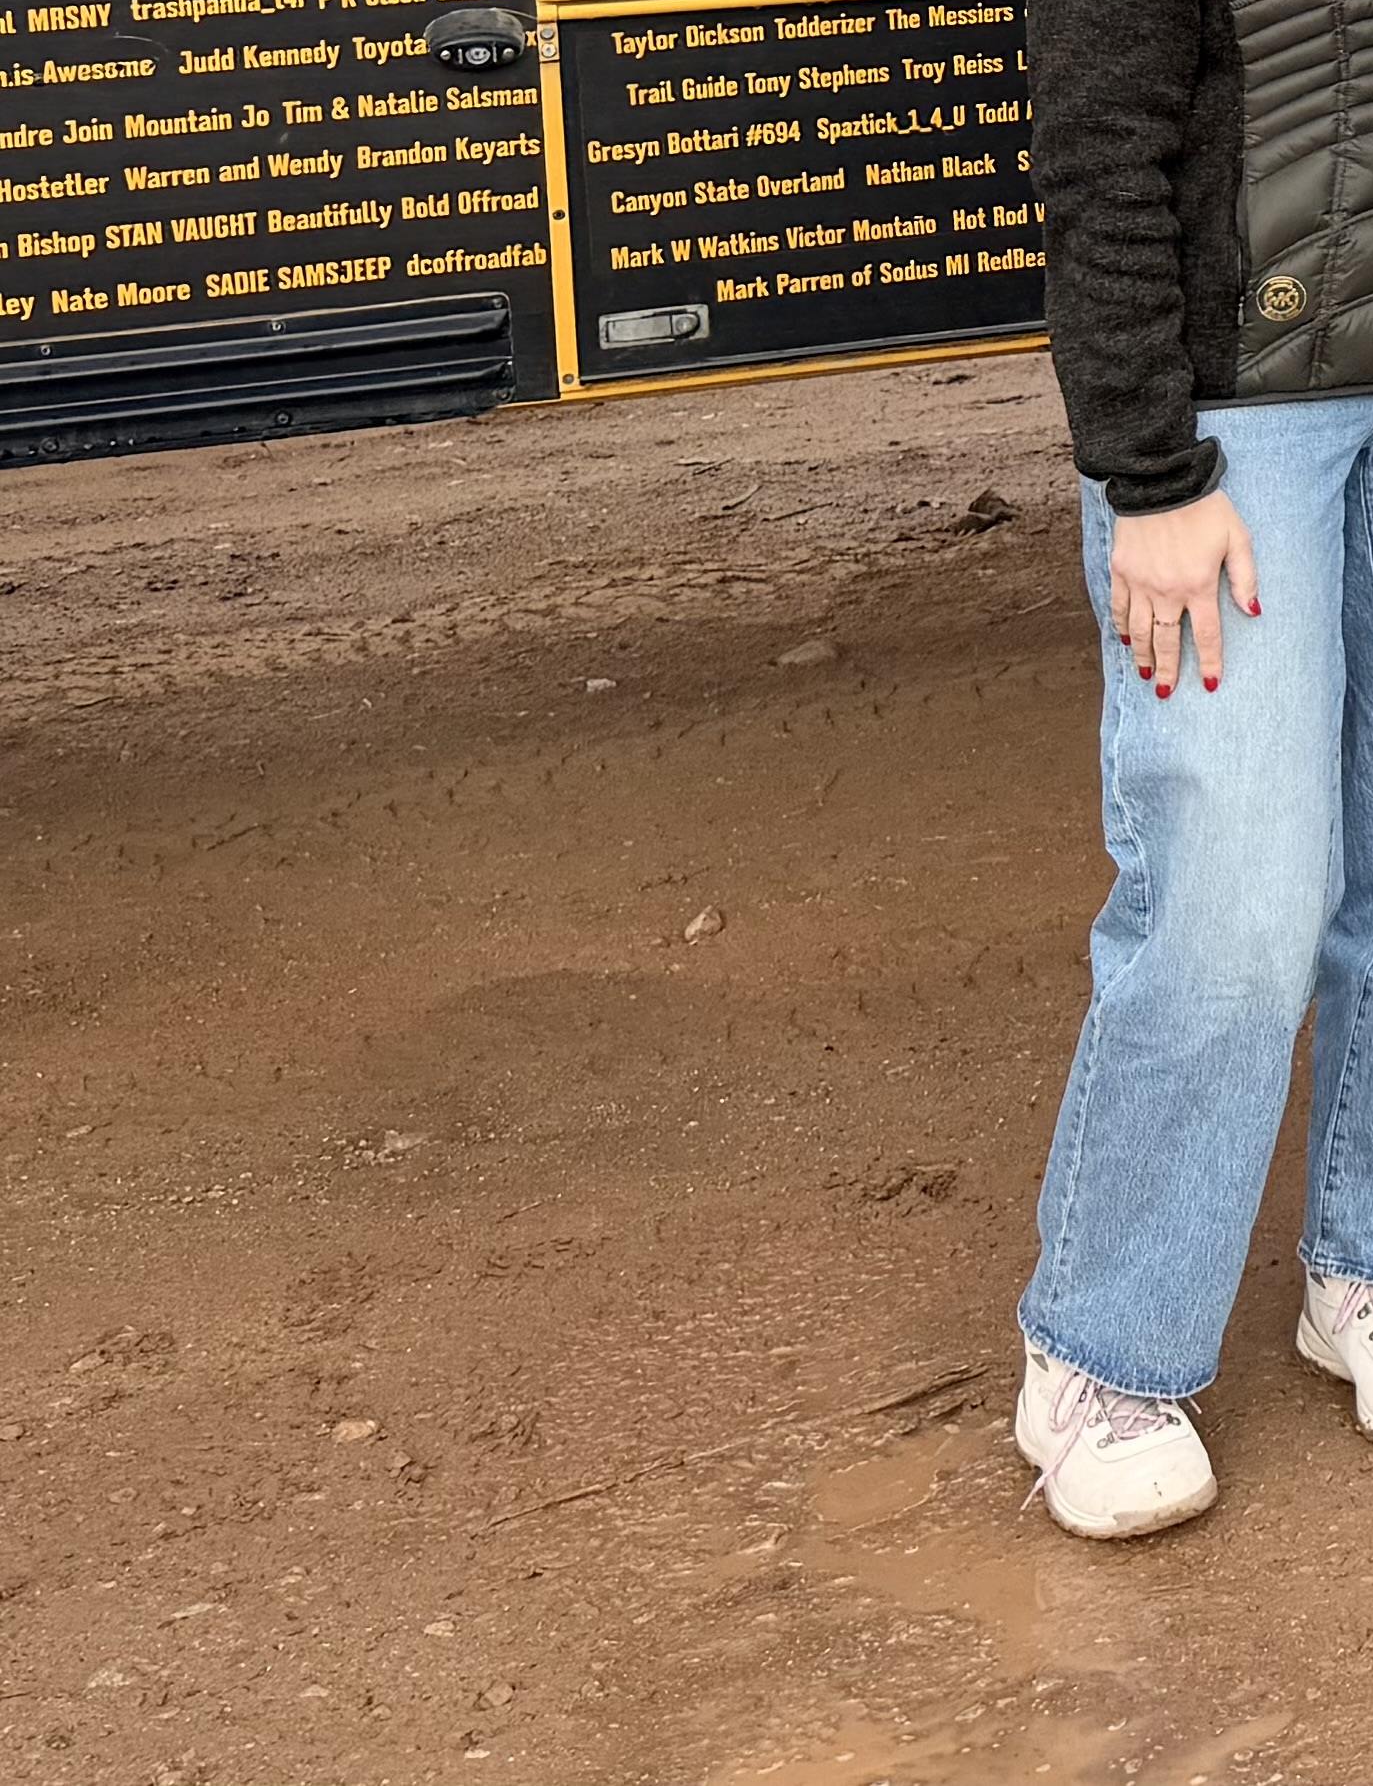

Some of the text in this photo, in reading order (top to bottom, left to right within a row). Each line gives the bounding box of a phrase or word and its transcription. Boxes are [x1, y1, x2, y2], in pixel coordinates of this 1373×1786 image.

[686, 9, 920, 47] Dickson The
[179, 48, 234, 74] Judd
[627, 59, 945, 105] Trail Guide Tony Troy
[63, 86, 537, 143] Join Jo Tim Salsman
[588, 102, 1018, 164] Gresyn #694 Todd
[124, 142, 446, 190] Warren Brandon
[611, 161, 934, 215] Canyon Nathan
[18, 187, 538, 258] Bishop STAN Bold Offroad
[671, 206, 1027, 262] W Victor Hot Rod
[52, 269, 269, 313] Nate Moore SADIE
[717, 262, 938, 302] Mark of Sodus
